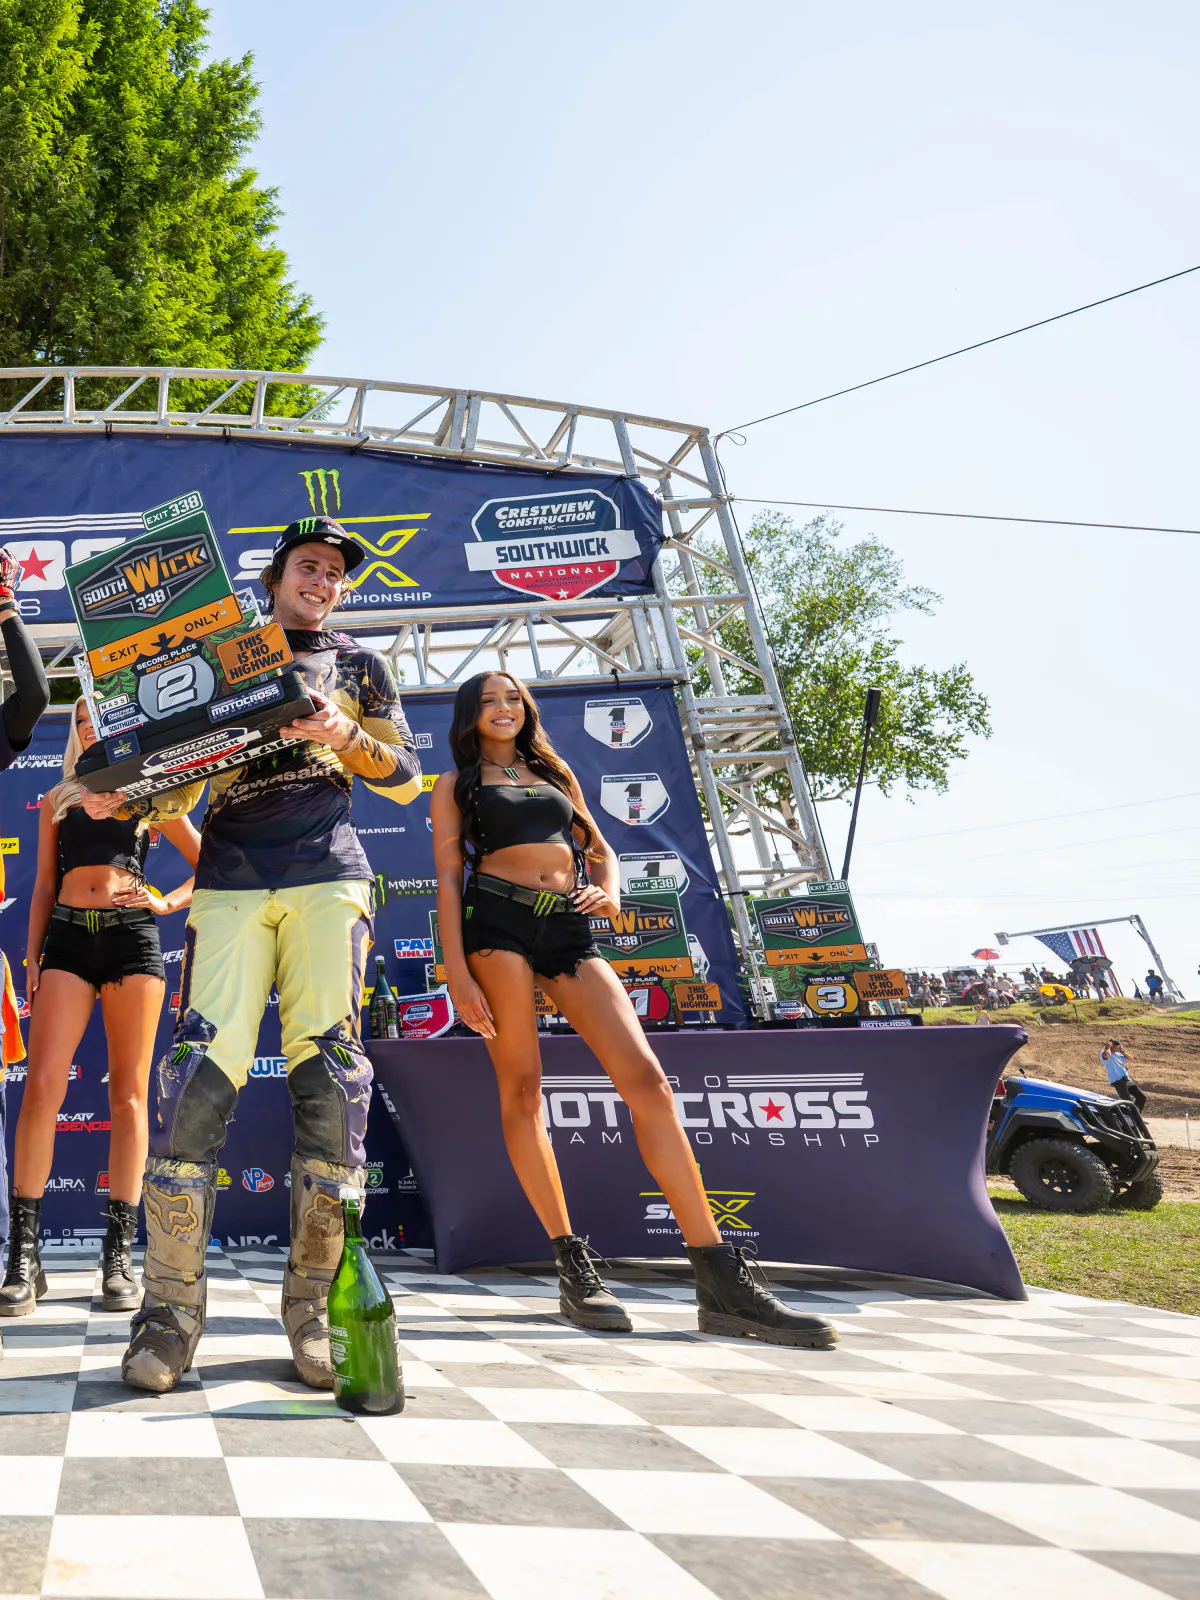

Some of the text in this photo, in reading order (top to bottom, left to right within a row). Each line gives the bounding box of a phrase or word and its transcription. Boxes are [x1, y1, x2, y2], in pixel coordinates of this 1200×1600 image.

[146, 494, 200, 525] EXIT 338
[495, 500, 594, 520] CRESTVIEW
[498, 511, 596, 529] CONSTRUCTION
[233, 528, 420, 588] SX
[496, 537, 610, 564] SOUTHWICK
[511, 566, 604, 579] NATIONAL
[135, 589, 166, 612] 338
[109, 611, 220, 663] EXIT ONLY
[236, 634, 263, 651] THIS
[136, 643, 198, 671] SECOND PLACE
[163, 652, 192, 666] CLASS
[237, 644, 270, 663] IS NO
[229, 650, 285, 680] HIGHWAY
[157, 663, 197, 713] 2
[101, 698, 125, 710] MASS
[211, 686, 280, 716] MOTOCROSS
[108, 717, 141, 733] SOUTHWICK
[162, 739, 241, 769] SOUTHWICK
[358, 827, 406, 835] MARINES
[388, 879, 438, 890] MONSTE
[631, 878, 674, 889] EXIT 338
[826, 882, 846, 891] 338
[614, 935, 638, 946] 338
[799, 928, 819, 937] 338
[648, 964, 677, 973] ONLY
[862, 989, 905, 998] HIGHWAY
[880, 981, 893, 989] NO
[680, 1000, 718, 1008] HIGHWAY
[817, 985, 847, 1009] 3
[243, 1168, 264, 1190] VP
[370, 1173, 378, 1183] 2
